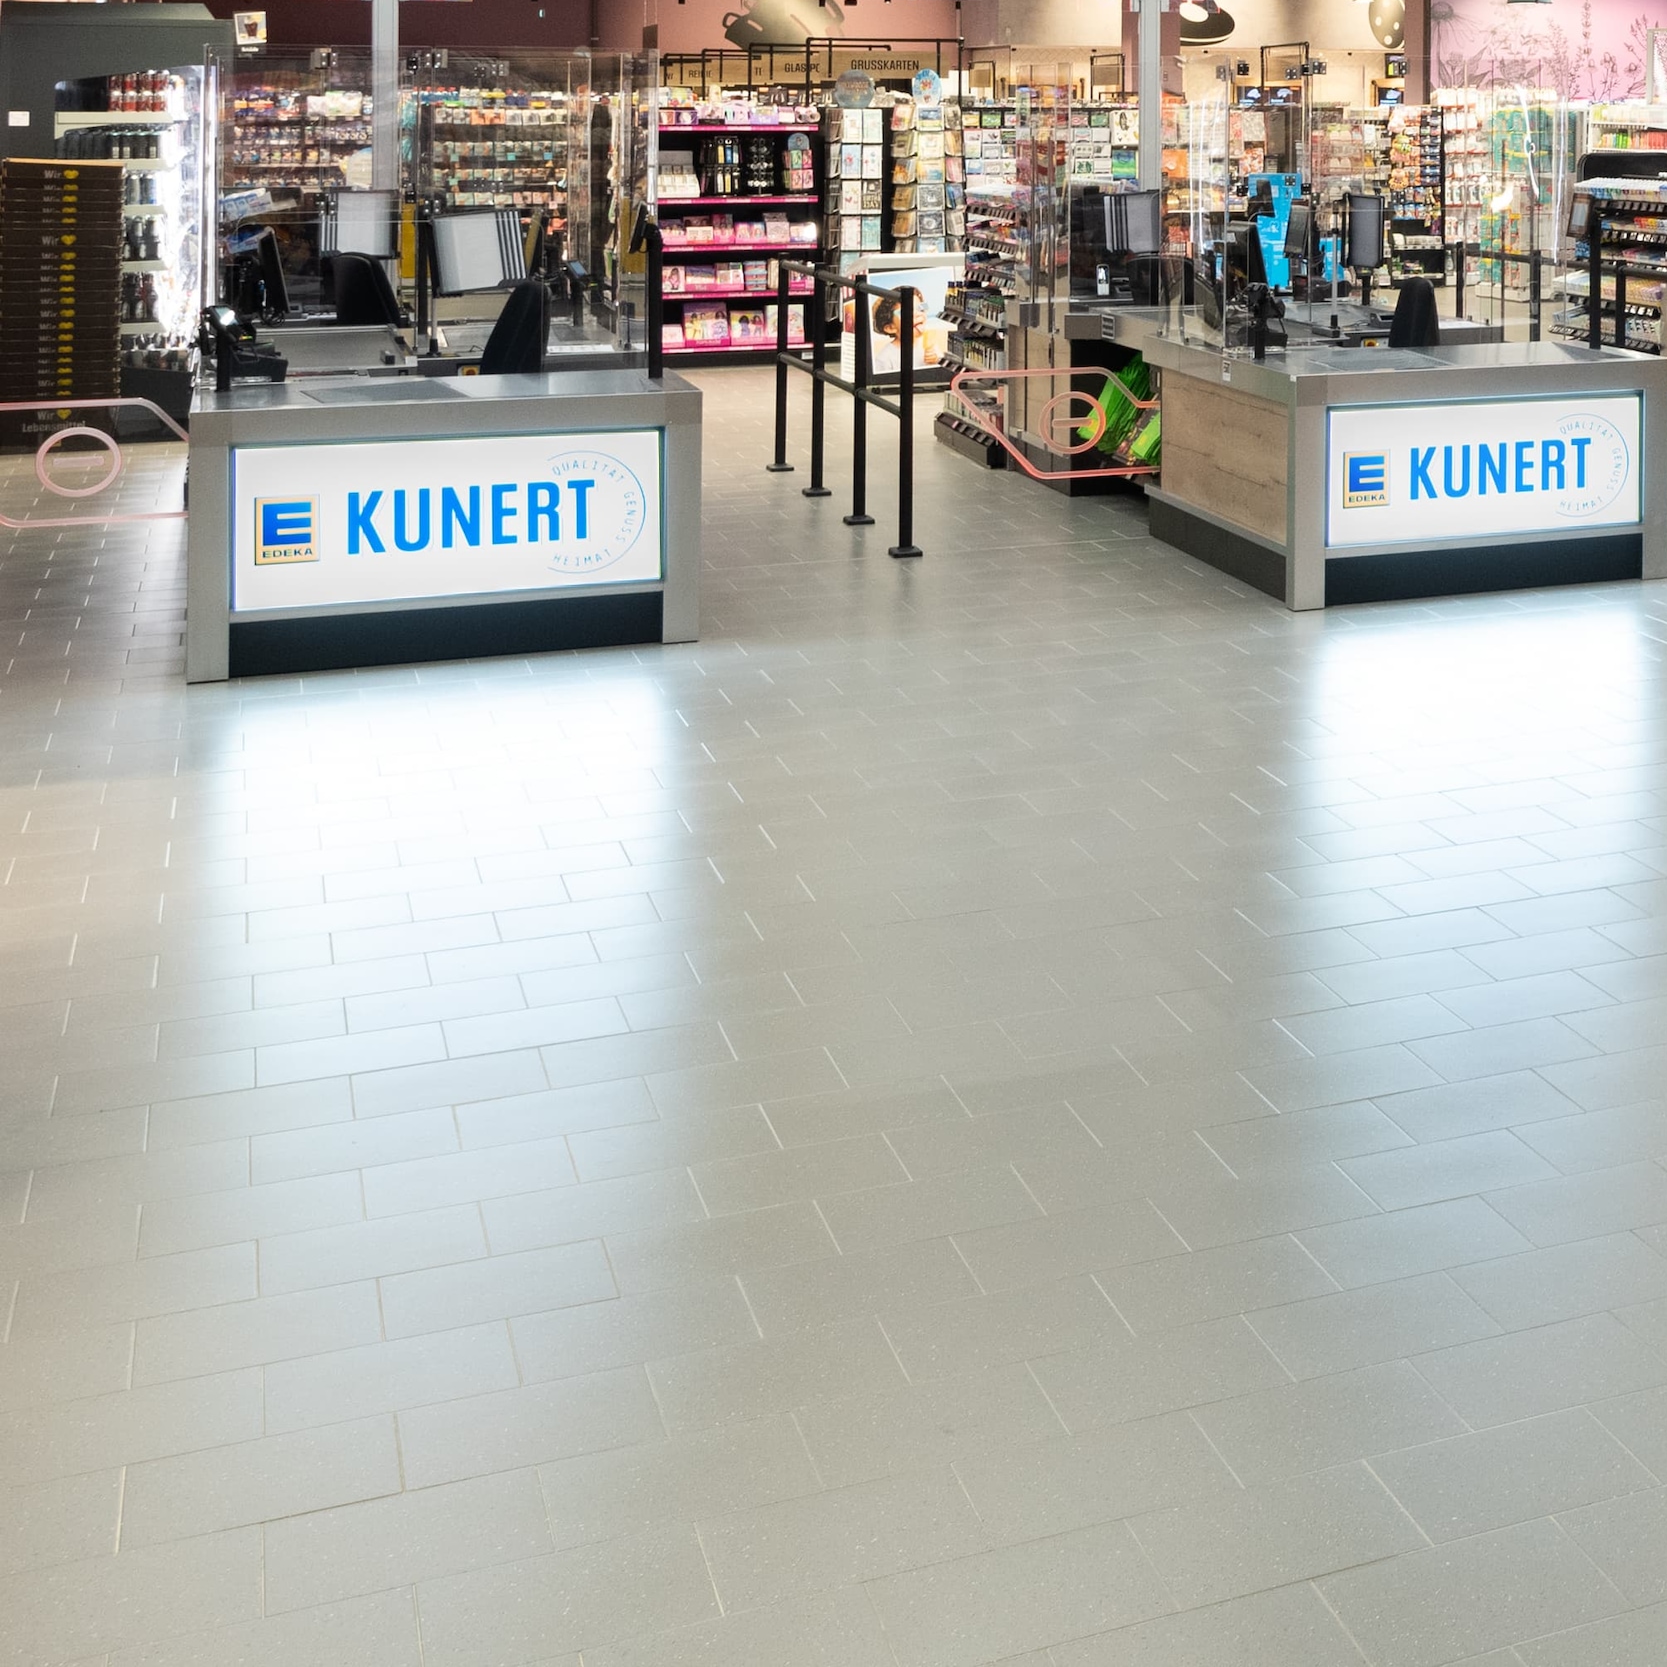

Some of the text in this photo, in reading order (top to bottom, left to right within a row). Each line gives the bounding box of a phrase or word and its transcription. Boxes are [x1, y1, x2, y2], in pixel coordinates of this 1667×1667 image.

[851, 59, 919, 71] GRUSSKARTEN
[1409, 437, 1592, 501] KUNERT
[1349, 493, 1386, 503] EDEKA
[346, 479, 595, 555] KUNERT
[615, 490, 638, 544] GENUSS
[261, 547, 314, 559] EDEKA
[551, 547, 613, 568] HEIMAT
